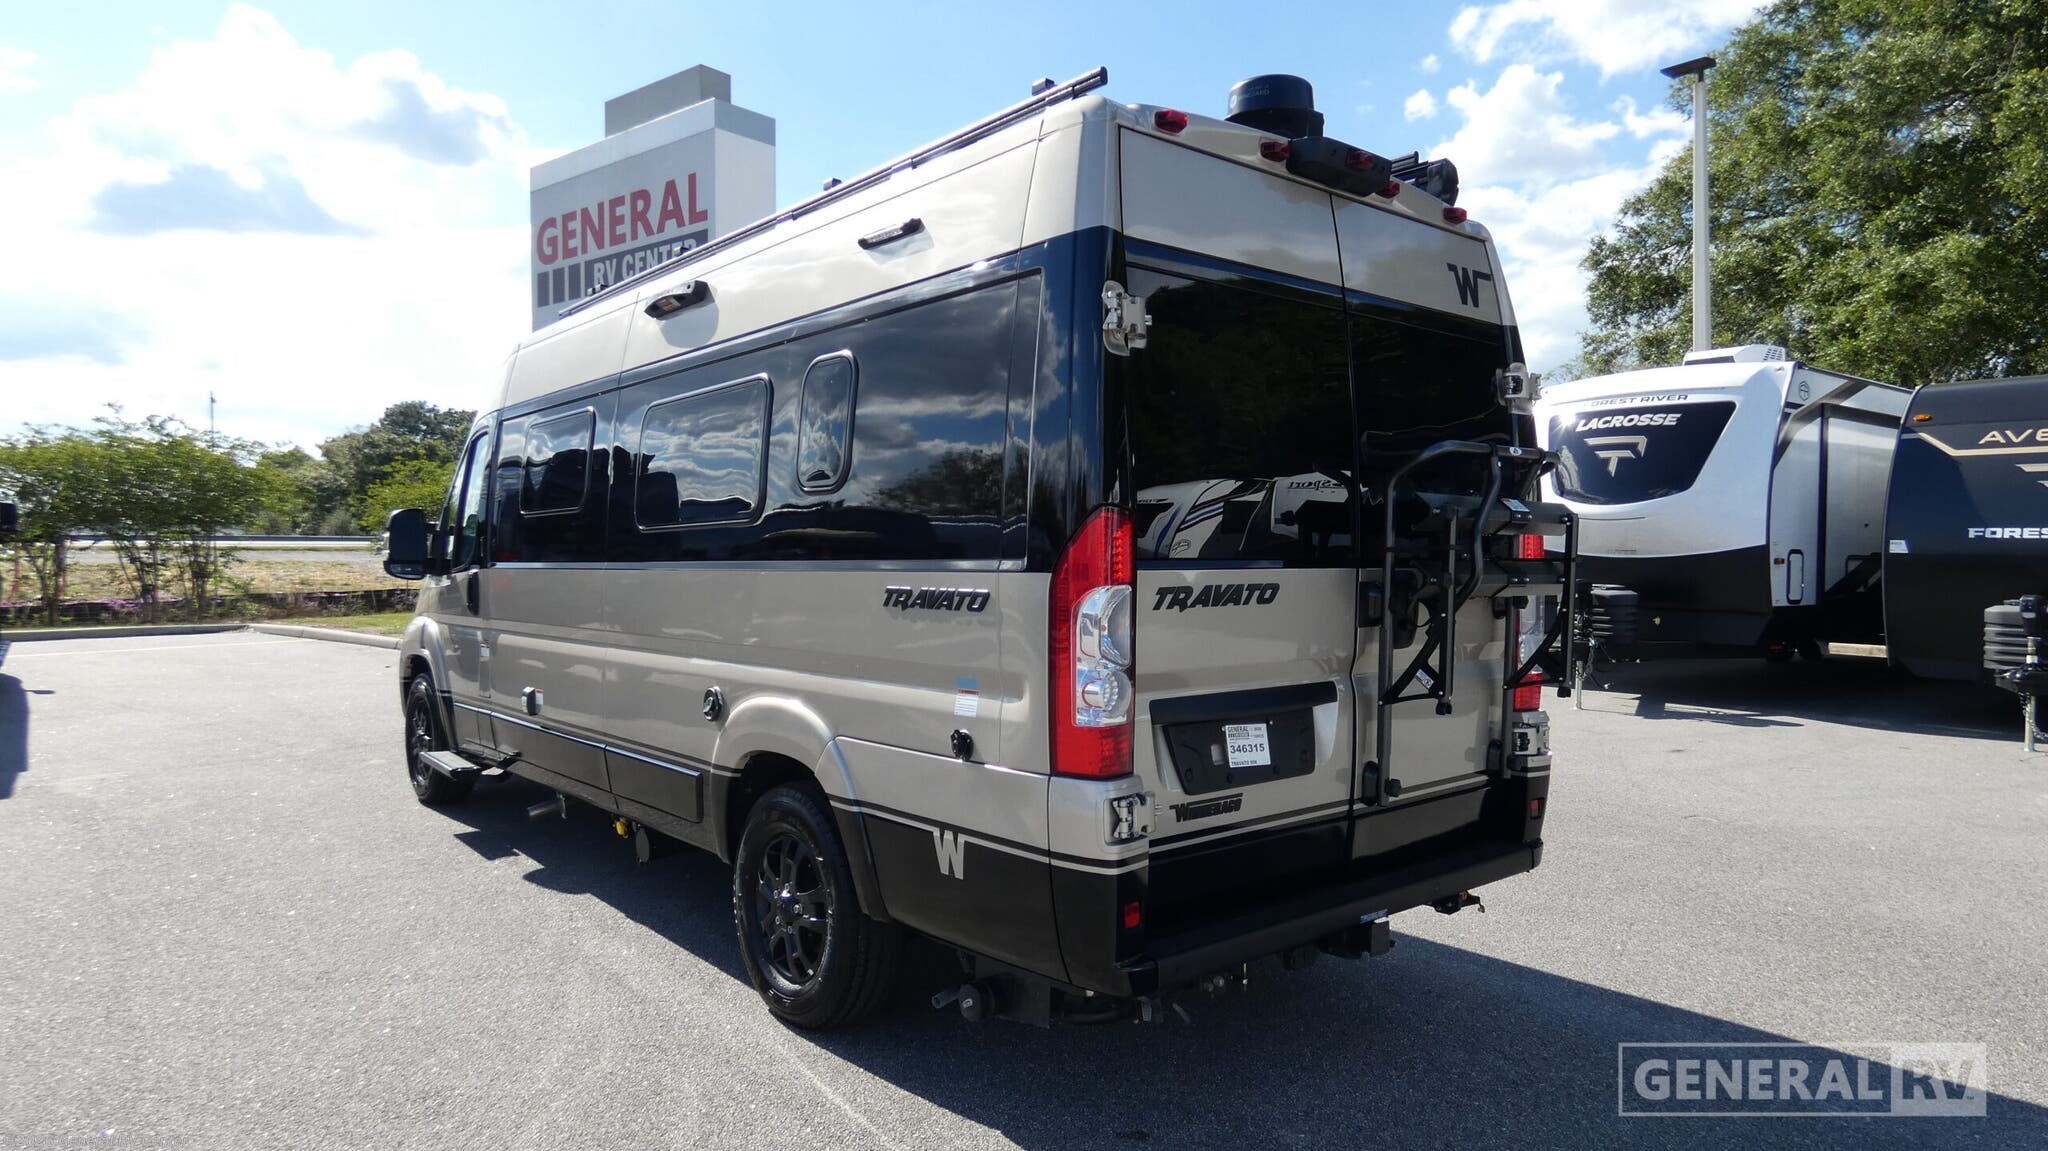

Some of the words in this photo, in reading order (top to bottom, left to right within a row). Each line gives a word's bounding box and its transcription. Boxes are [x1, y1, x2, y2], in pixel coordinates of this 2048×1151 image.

[537, 172, 708, 265] GENERAL
[593, 258, 616, 287] RV
[1447, 262, 1493, 308] W
[1640, 394, 1688, 402] RIVER
[1575, 413, 1682, 432] LACROSSE
[882, 586, 991, 613] TRAVATO
[1152, 583, 1280, 613] TRAVATO
[1230, 743, 1265, 753] 346315
[932, 828, 967, 880] W
